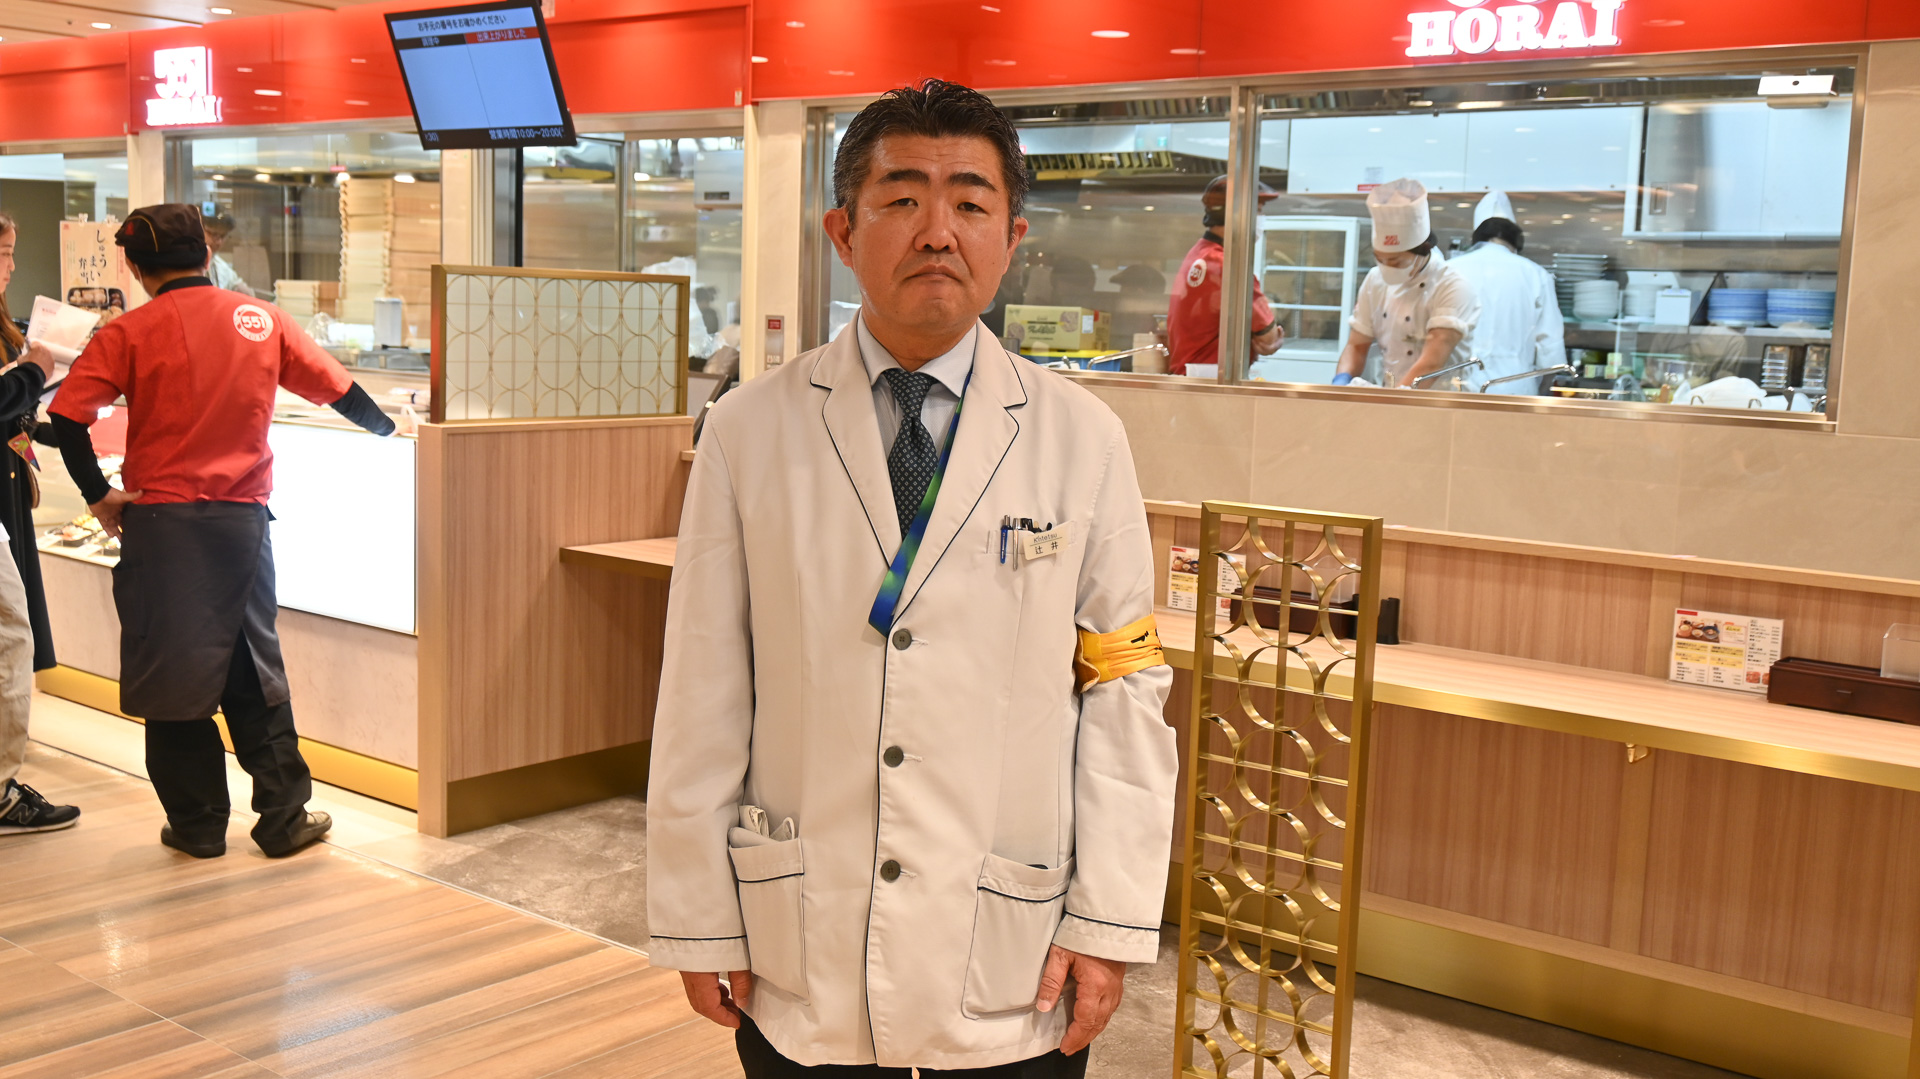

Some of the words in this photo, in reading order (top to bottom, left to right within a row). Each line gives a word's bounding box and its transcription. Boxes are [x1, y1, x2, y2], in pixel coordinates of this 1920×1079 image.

[417, 14, 507, 32] お手元の番号をお確かめください
[1405, 1, 1621, 57] HORAI
[476, 29, 527, 43] 出来上がりました
[241, 314, 266, 329] 551
